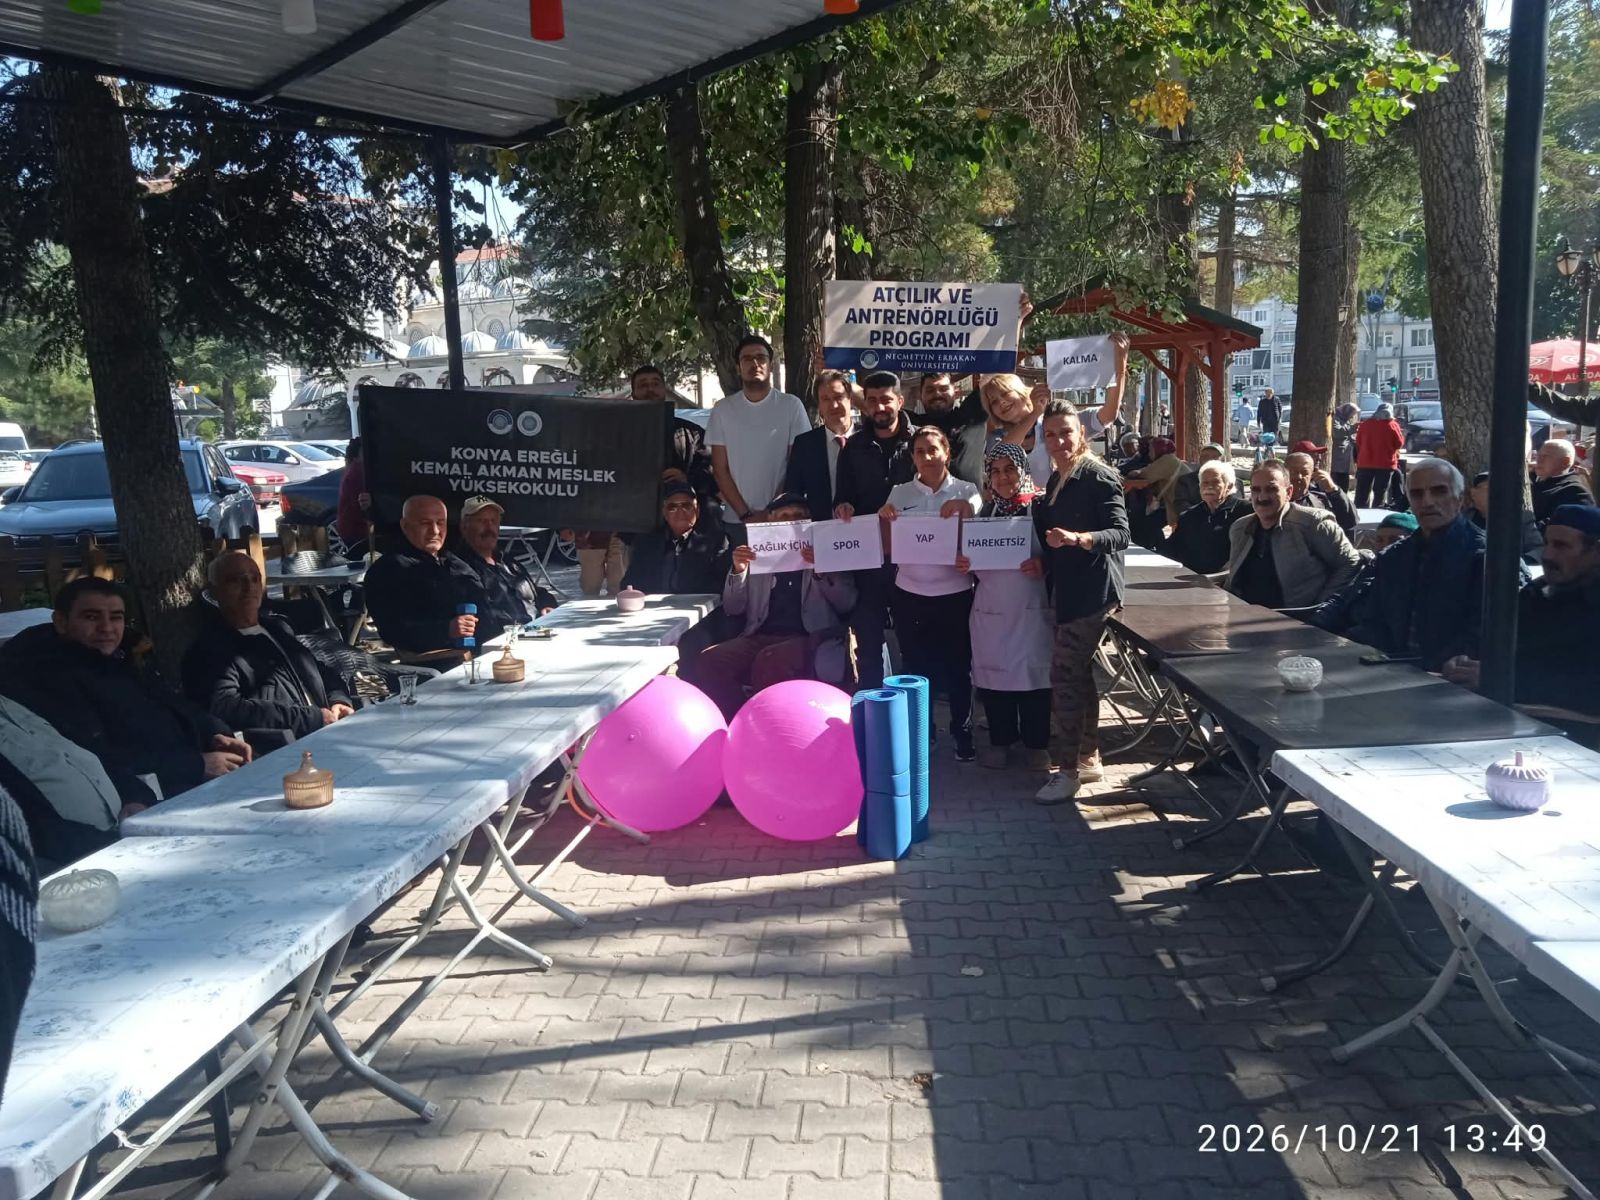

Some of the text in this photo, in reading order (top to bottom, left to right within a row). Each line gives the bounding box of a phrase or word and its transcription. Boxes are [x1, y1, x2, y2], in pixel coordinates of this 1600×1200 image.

[873, 287, 972, 306] ATÇILIK VE
[845, 306, 998, 326] ANTRENÖRLÜĞÜ
[869, 330, 970, 348] PROGRAMI
[938, 353, 977, 363] ERBAKAN
[1063, 353, 1098, 366] KALMA
[451, 447, 577, 465] KONYA EREĞLİ
[411, 461, 616, 483] KEMAL AKMAN MESLEK
[450, 475, 579, 497] YÜKSEKOKULU
[833, 539, 860, 551] SPOR
[915, 533, 935, 543] YAP
[967, 536, 1026, 548] HAREKETSİZ
[752, 541, 788, 553] SAĞLIK
